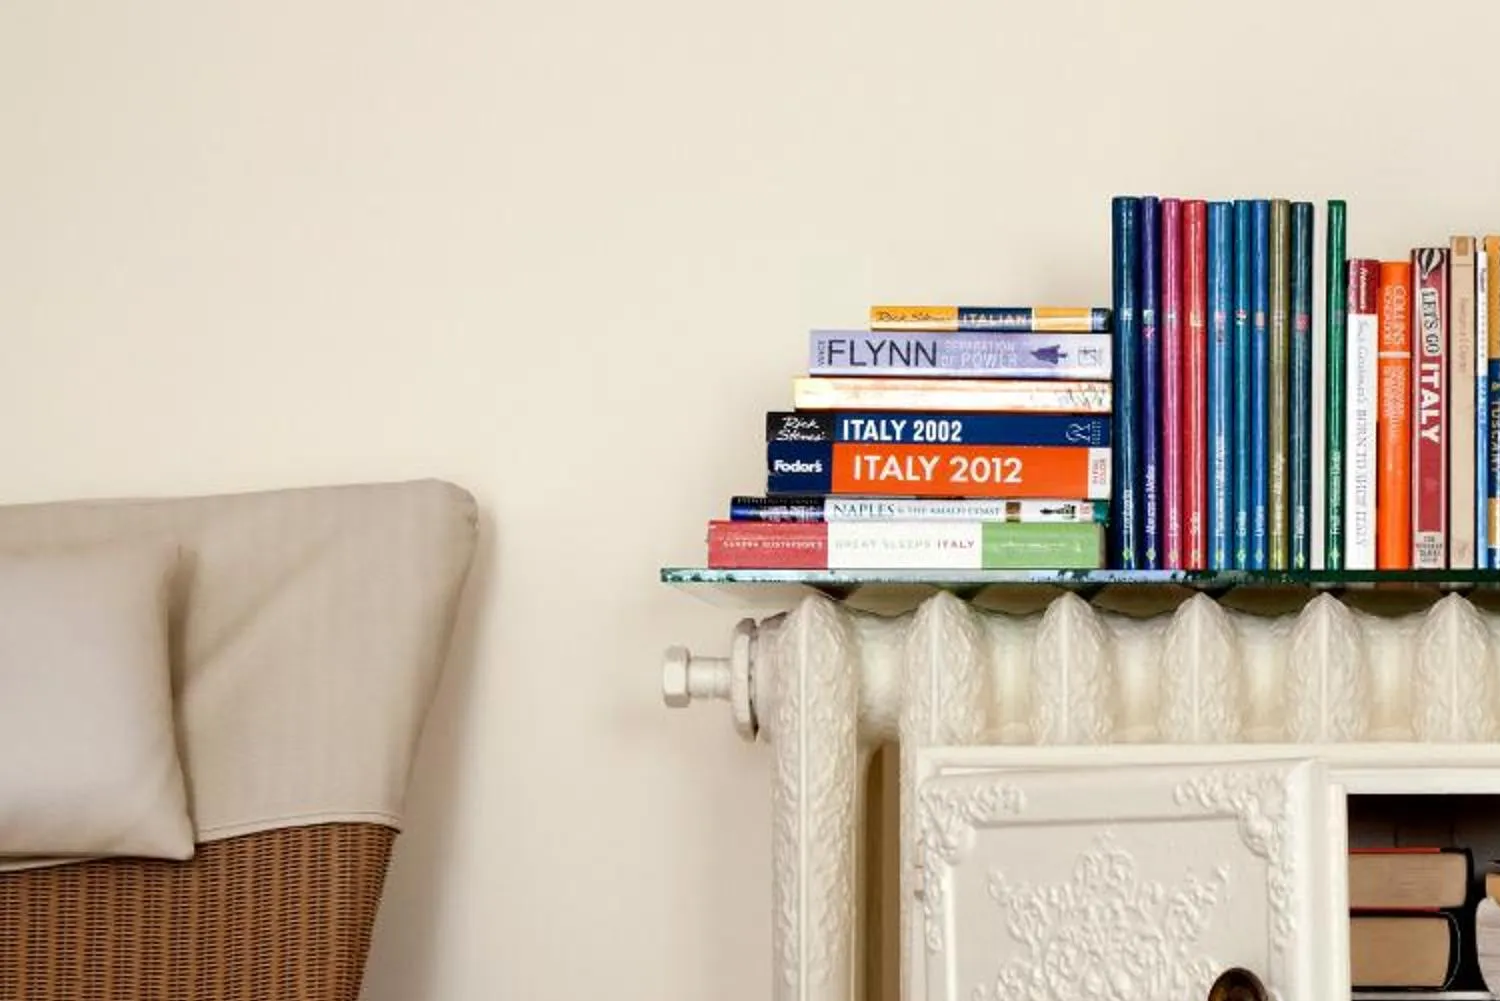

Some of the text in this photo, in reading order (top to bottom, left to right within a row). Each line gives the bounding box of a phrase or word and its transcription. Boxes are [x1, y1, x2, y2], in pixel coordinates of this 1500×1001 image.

[1394, 284, 1407, 345] COLLINS
[1421, 290, 1441, 354] LET'S GO
[827, 339, 937, 367] FLYNN
[1418, 362, 1441, 444] ITALY
[782, 415, 821, 431] Rick
[842, 419, 963, 443] ITALY 2002
[1355, 408, 1368, 447] BORN
[773, 459, 823, 474] Fodor's
[852, 455, 1024, 484] ITALY 2012
[833, 503, 896, 517] NAPLES
[936, 539, 976, 551] ITALY
